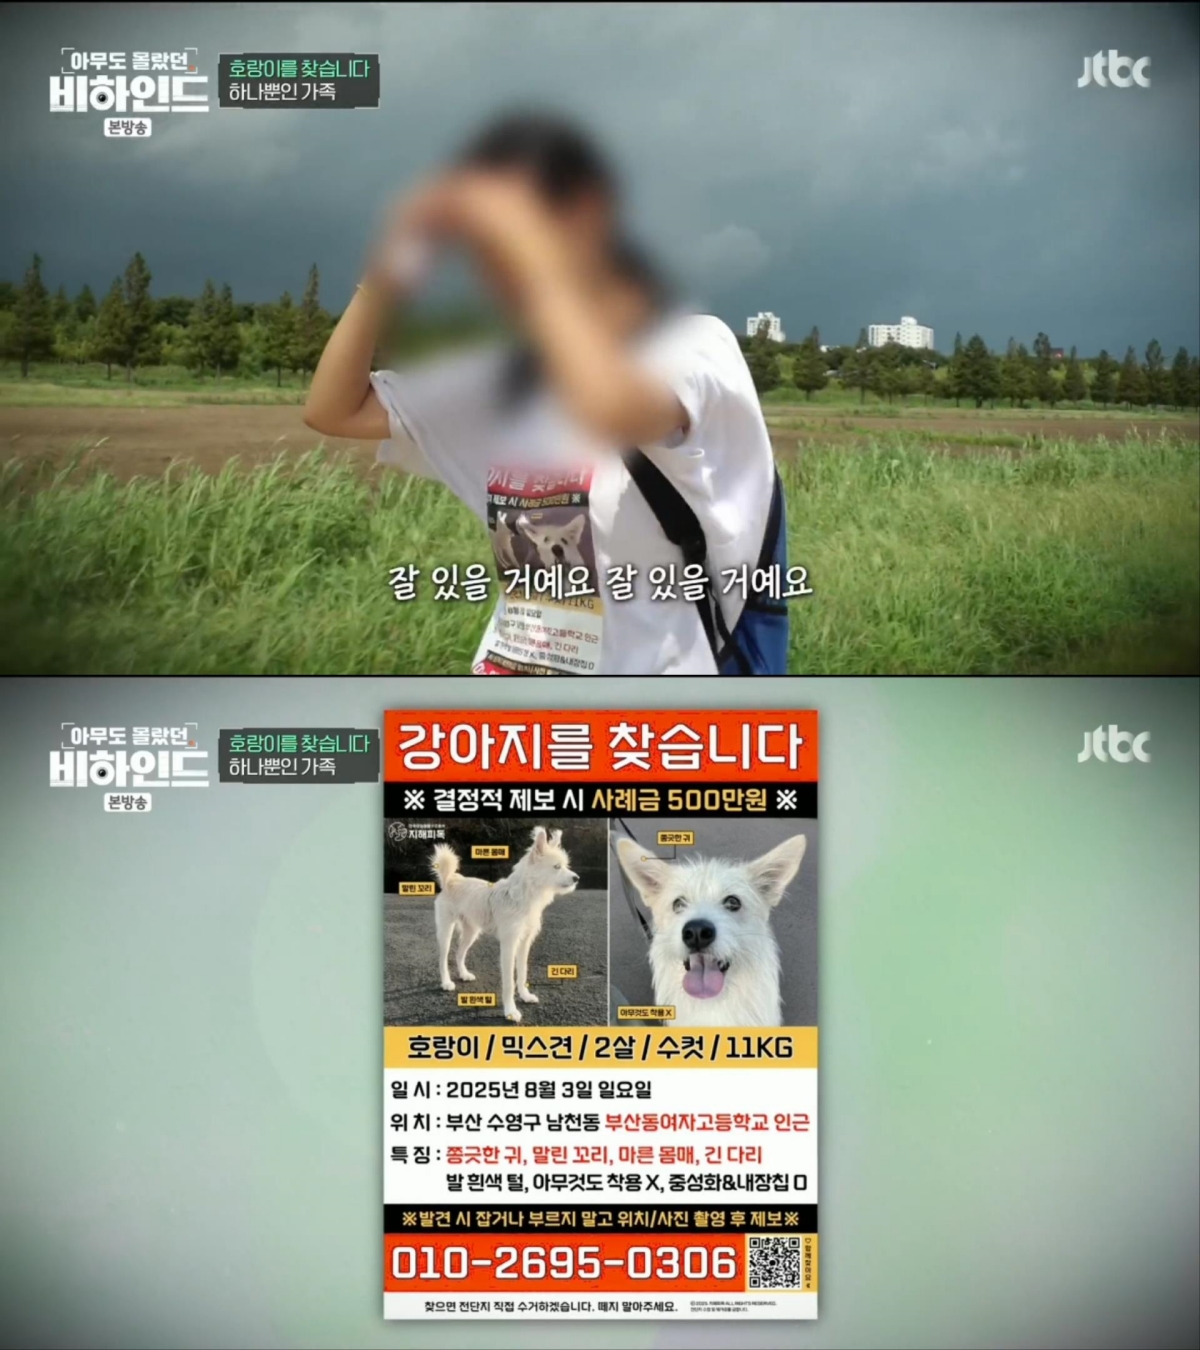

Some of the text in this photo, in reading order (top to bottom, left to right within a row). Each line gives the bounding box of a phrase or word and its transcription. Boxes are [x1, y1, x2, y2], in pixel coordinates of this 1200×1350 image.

[399, 723, 803, 771] 강아지를 찾습니다
[434, 788, 767, 811] 결정적 제보 시 사례금 500만원
[551, 968, 575, 976] 긴 다리
[620, 1008, 650, 1017] 아무것도
[665, 1008, 672, 1017] X
[408, 1035, 793, 1060] 호랑이 믹스견 2살 수컷 11KG
[391, 1081, 652, 1099] 일 시 2025년 8월 3일 일요일
[390, 1113, 810, 1131] 위 치 부산 수영구 남천동 부산동여자고등학교 인근
[390, 1146, 762, 1166] 특 징 쫑긋한 귀, 말린 꼬리, 마른 몸매, 긴 다리
[446, 1173, 464, 1192] 발
[467, 1173, 502, 1192] 흰색
[507, 1173, 529, 1193] 털,
[533, 1173, 603, 1192] 아무것도
[607, 1173, 642, 1192] 착용
[646, 1173, 664, 1193] X,
[669, 1173, 789, 1192] 중성화&내장칩
[456, 1211, 471, 1228] 시
[476, 1211, 524, 1228] 잡거나
[528, 1211, 576, 1228] 부르지
[581, 1211, 613, 1228] 말고
[617, 1211, 689, 1228] 위치/사진
[694, 1211, 725, 1228] 촬영
[730, 1211, 746, 1228] 후
[393, 1246, 736, 1280] 010-2695-0306
[425, 1301, 456, 1313] 찾으면
[459, 1301, 491, 1313] 전단지
[493, 1301, 515, 1313] 직접
[517, 1301, 595, 1313] 수거하겠습니다.
[598, 1301, 619, 1313] 떼지
[622, 1301, 678, 1313] 말아주세요.
